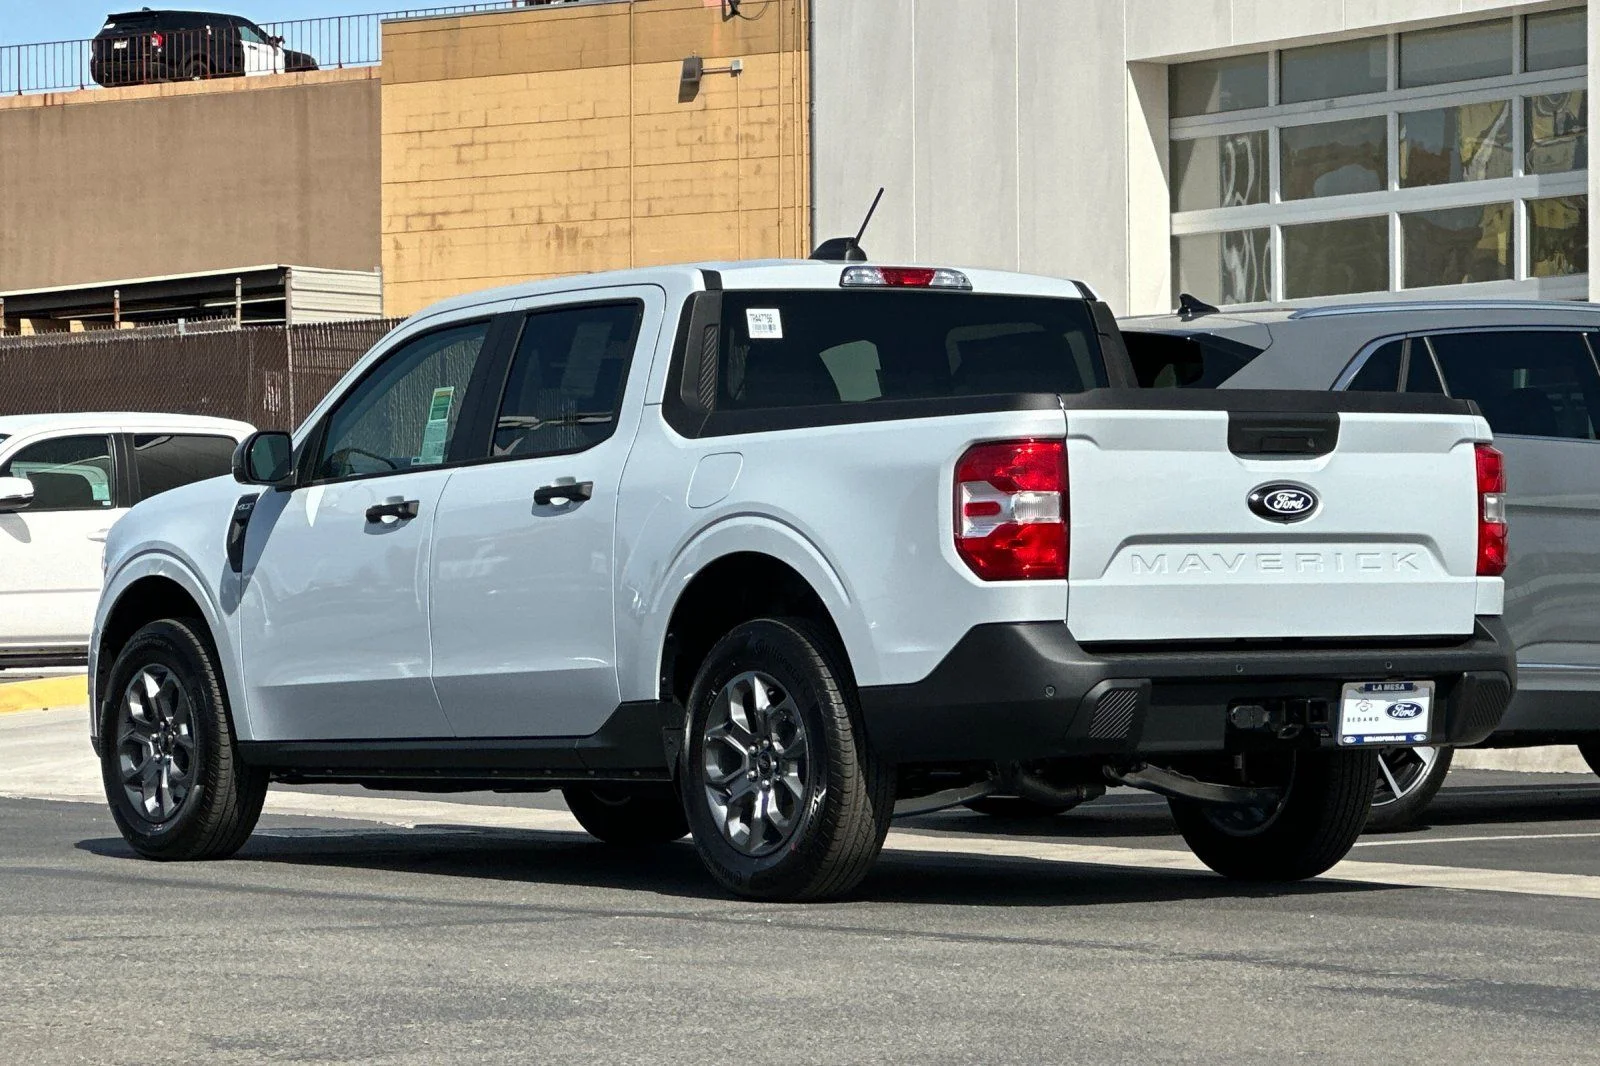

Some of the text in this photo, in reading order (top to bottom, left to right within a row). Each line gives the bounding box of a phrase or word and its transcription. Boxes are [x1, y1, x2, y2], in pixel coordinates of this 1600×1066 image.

[1273, 492, 1305, 509] Ford
[1131, 552, 1420, 573] MAVERICK
[1392, 703, 1416, 717] Ford
